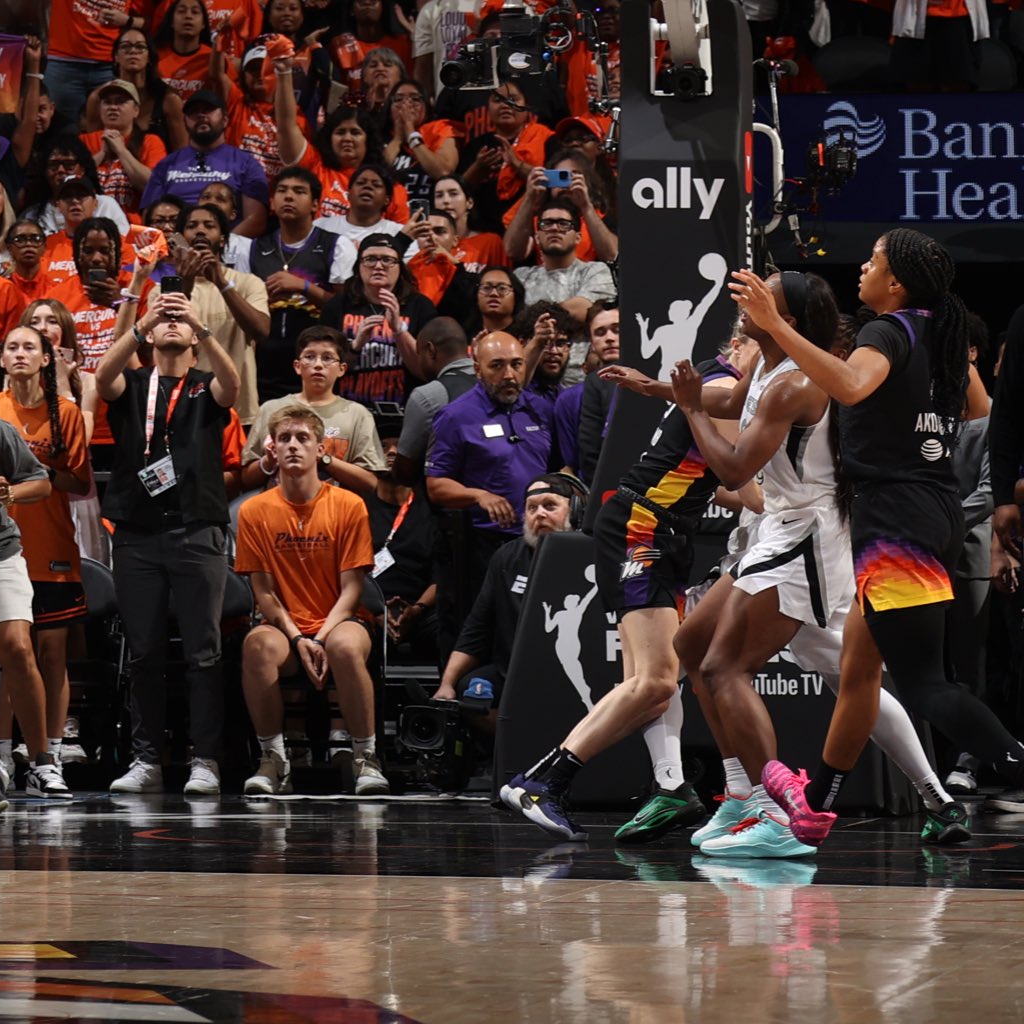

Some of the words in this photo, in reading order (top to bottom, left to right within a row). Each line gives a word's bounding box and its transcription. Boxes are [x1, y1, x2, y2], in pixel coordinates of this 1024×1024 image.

[208, 9, 233, 20] CURY
[898, 109, 1024, 160] Ban
[632, 167, 725, 220] ally
[898, 168, 1024, 220] Hea
[276, 532, 330, 543] Phoenix
[800, 673, 824, 696] TV
